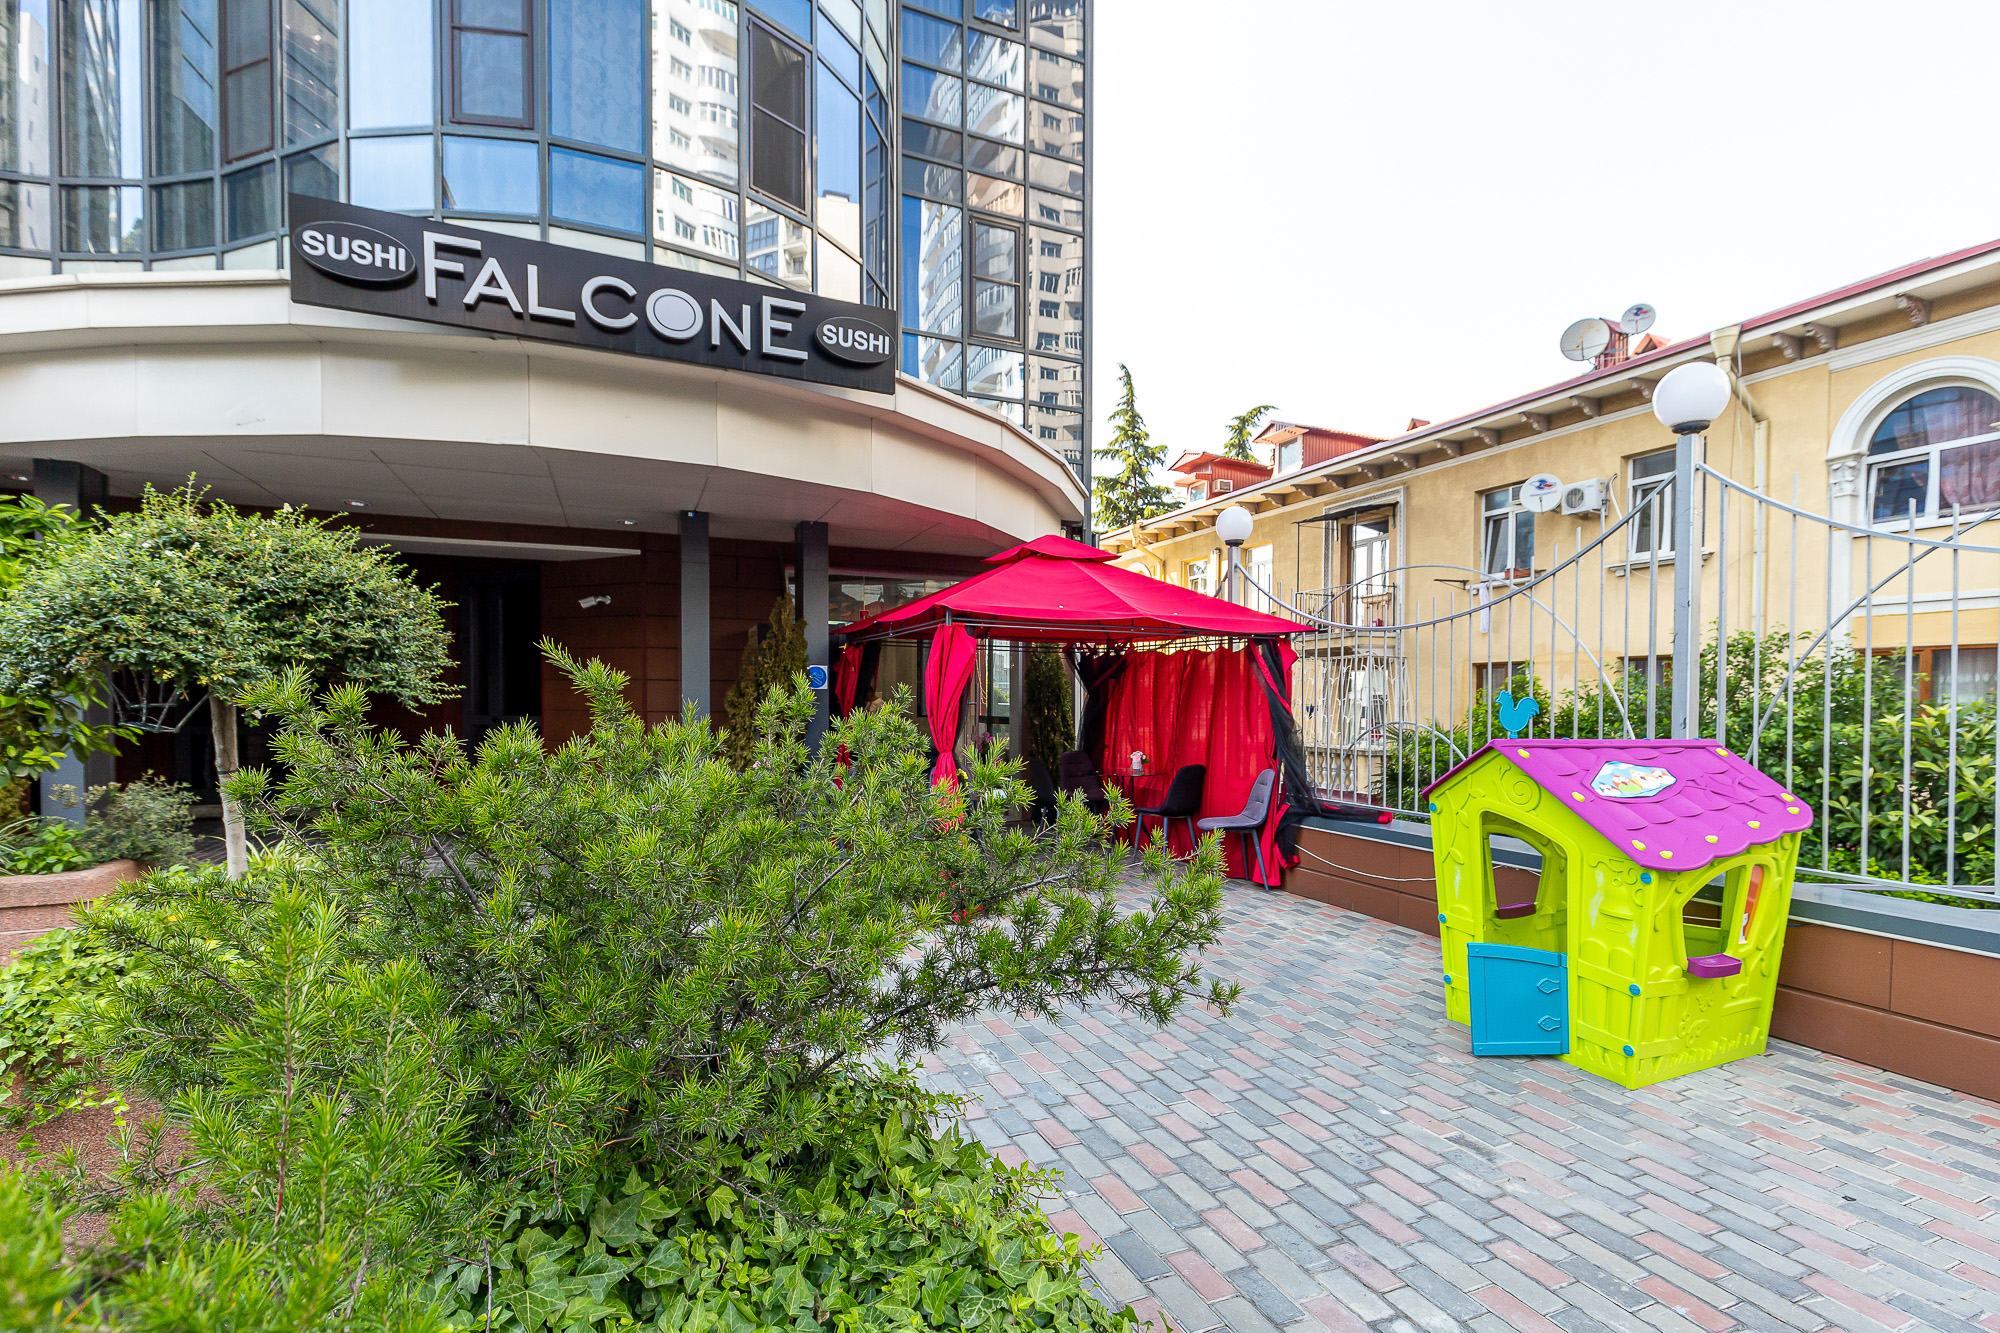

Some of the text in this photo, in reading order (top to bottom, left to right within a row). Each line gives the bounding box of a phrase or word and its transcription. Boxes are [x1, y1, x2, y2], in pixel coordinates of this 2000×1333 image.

[301, 229, 406, 272] SUSHI
[422, 230, 808, 360] FALCONE
[822, 324, 890, 355] SUSHI
